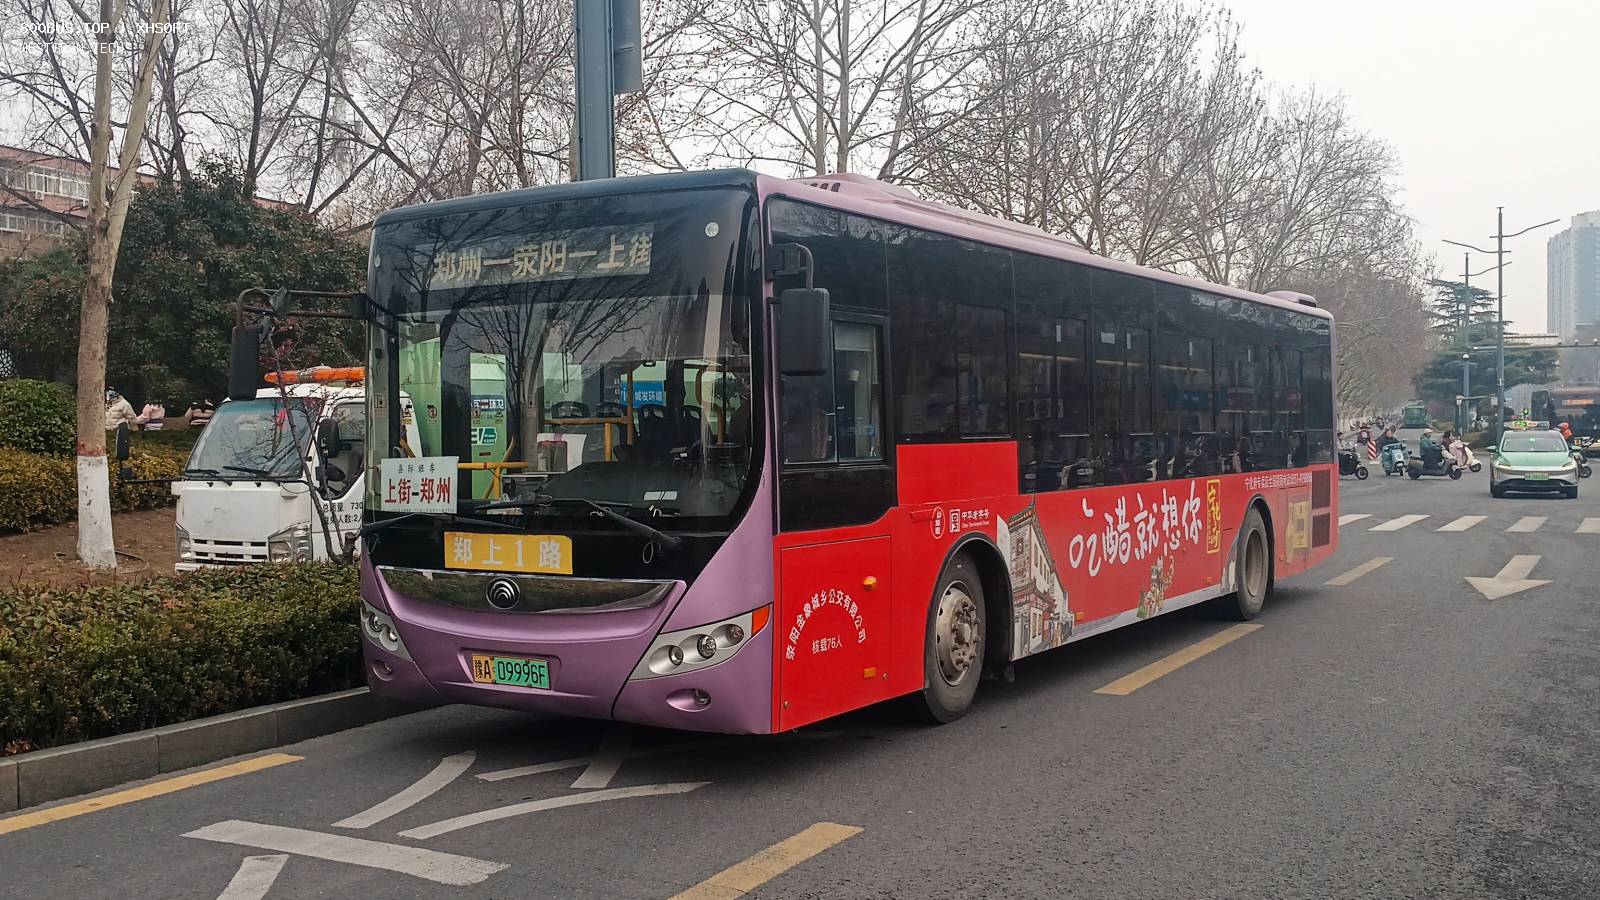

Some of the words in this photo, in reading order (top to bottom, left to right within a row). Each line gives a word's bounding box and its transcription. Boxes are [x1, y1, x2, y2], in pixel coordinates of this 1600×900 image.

[1069, 480, 1202, 577] 吃醋就想你
